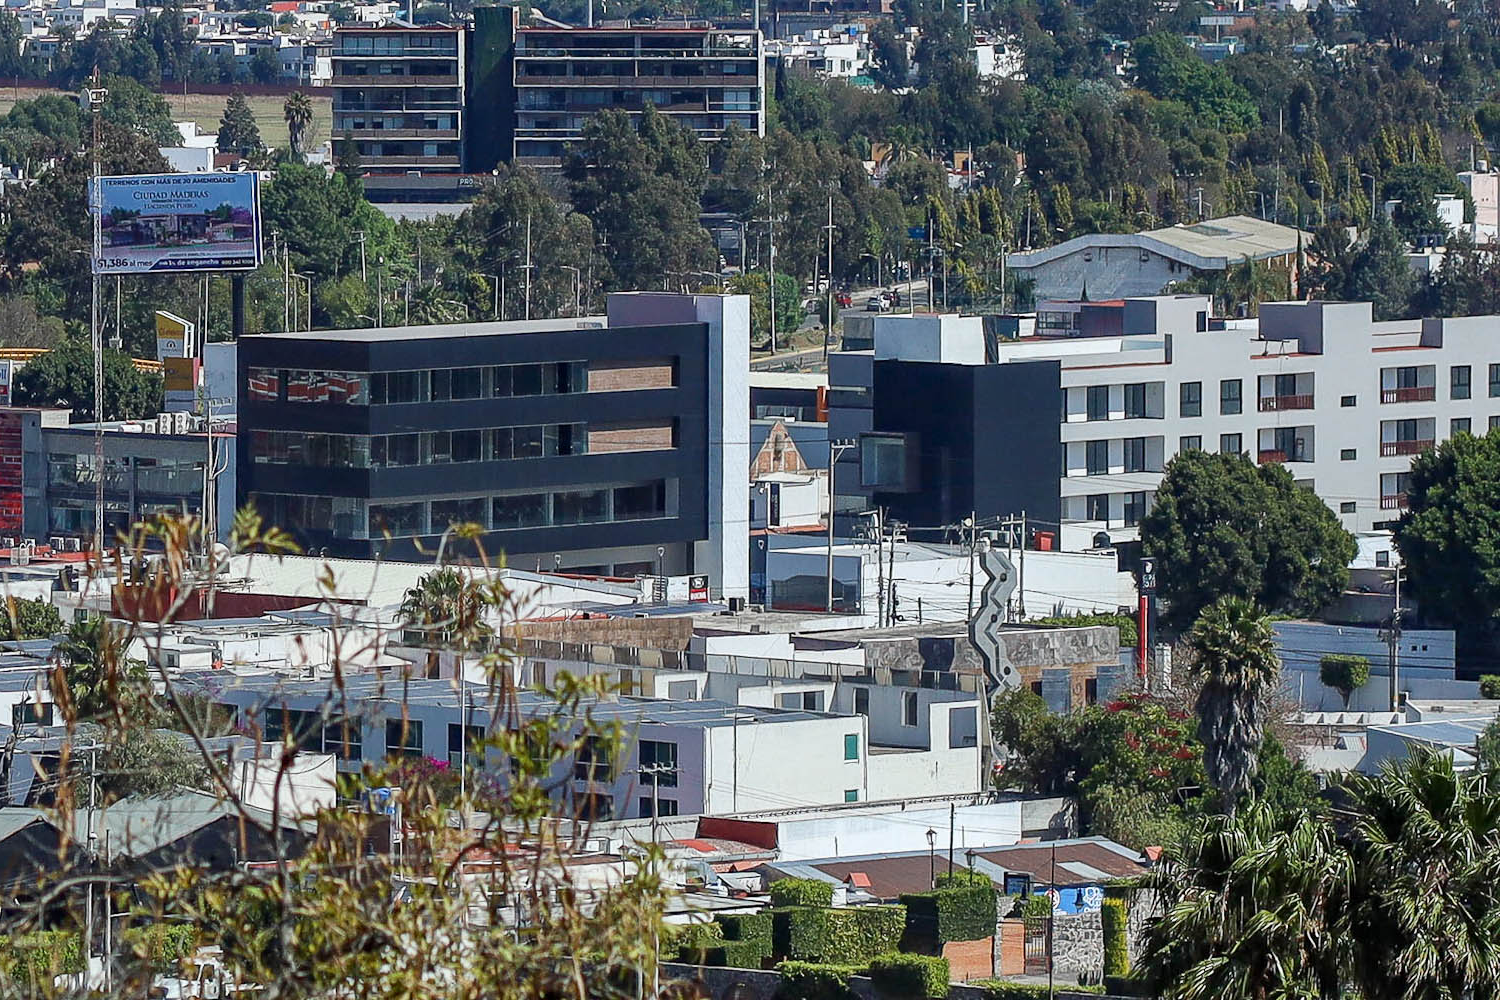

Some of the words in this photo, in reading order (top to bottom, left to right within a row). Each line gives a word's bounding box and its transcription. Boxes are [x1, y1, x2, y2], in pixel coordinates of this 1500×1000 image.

[141, 178, 156, 186] CON
[156, 177, 171, 185] MÁS
[192, 176, 237, 184] AMENIDADES
[133, 191, 168, 200] CIUDAD
[170, 190, 210, 199] MADERAS
